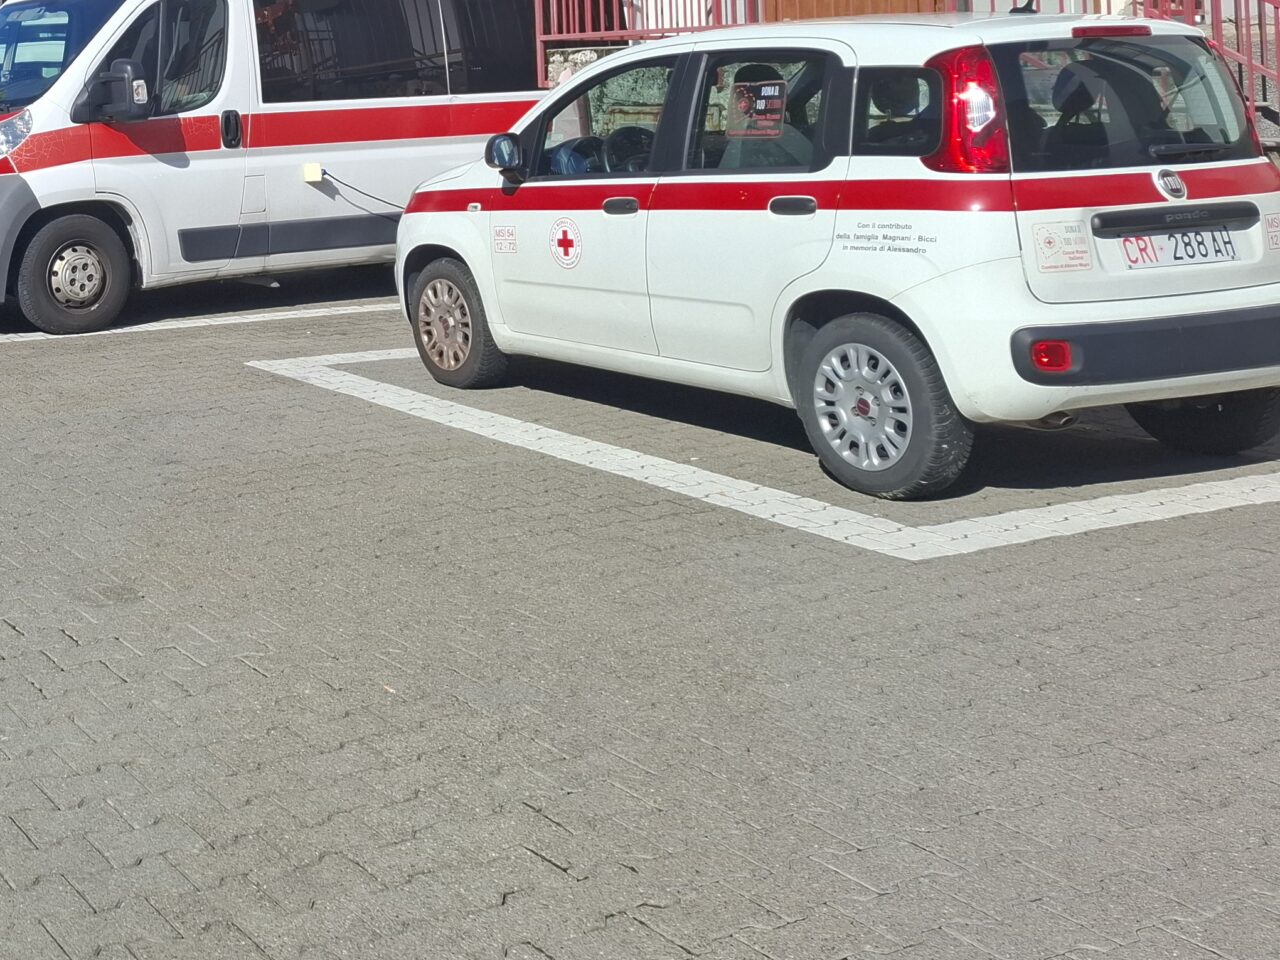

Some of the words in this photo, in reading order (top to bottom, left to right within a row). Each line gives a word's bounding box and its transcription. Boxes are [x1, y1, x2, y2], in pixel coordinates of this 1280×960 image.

[1165, 209, 1209, 223] panda
[857, 222, 871, 230] Con
[506, 228, 514, 238] 54
[853, 233, 879, 241] famiglia
[882, 233, 911, 243] Magnani
[886, 246, 927, 254] Alessandro
[1122, 235, 1159, 265] CRI
